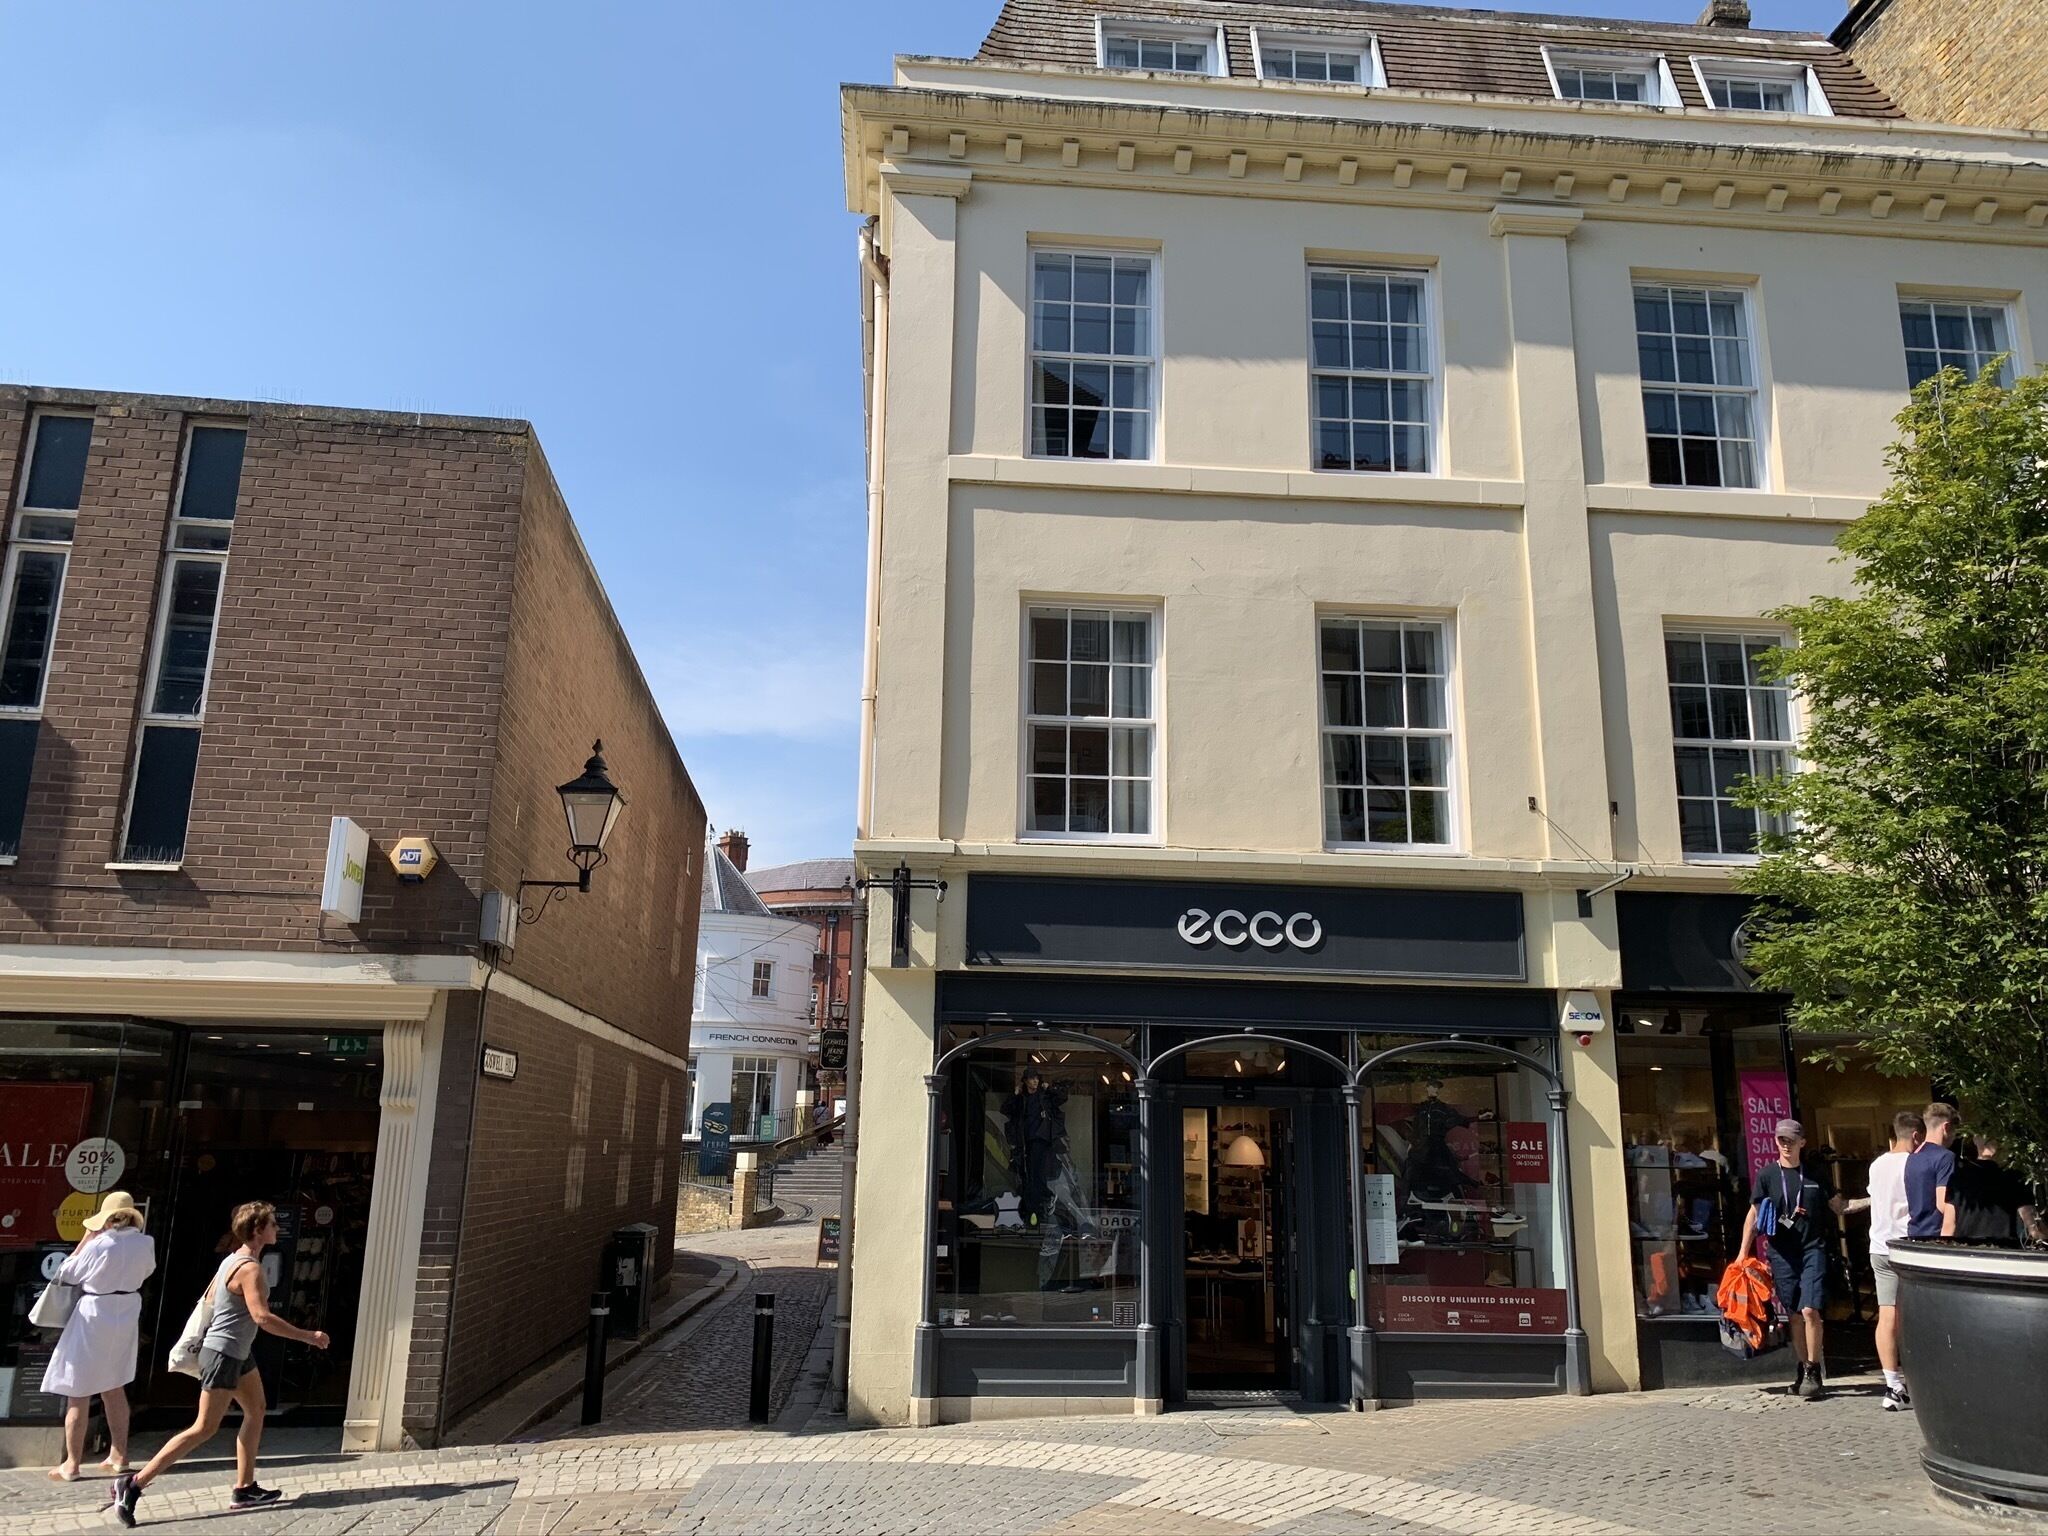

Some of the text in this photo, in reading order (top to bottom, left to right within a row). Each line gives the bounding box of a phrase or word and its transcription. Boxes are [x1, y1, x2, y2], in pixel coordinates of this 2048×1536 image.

[400, 851, 423, 862] ADT
[1177, 908, 1322, 949] ecco
[1568, 1011, 1601, 1021] SECOM
[709, 1033, 798, 1046] FRENCH CONNECTION
[1750, 1117, 1779, 1134] SAL
[1511, 1140, 1543, 1150] SALE
[1752, 1137, 1779, 1154] SAL
[0, 1142, 69, 1168] ALE
[77, 1150, 115, 1165] 50%
[81, 1165, 109, 1175] OFF
[1402, 1295, 1536, 1305] DISCOVER UNLIMITED SERVICE
